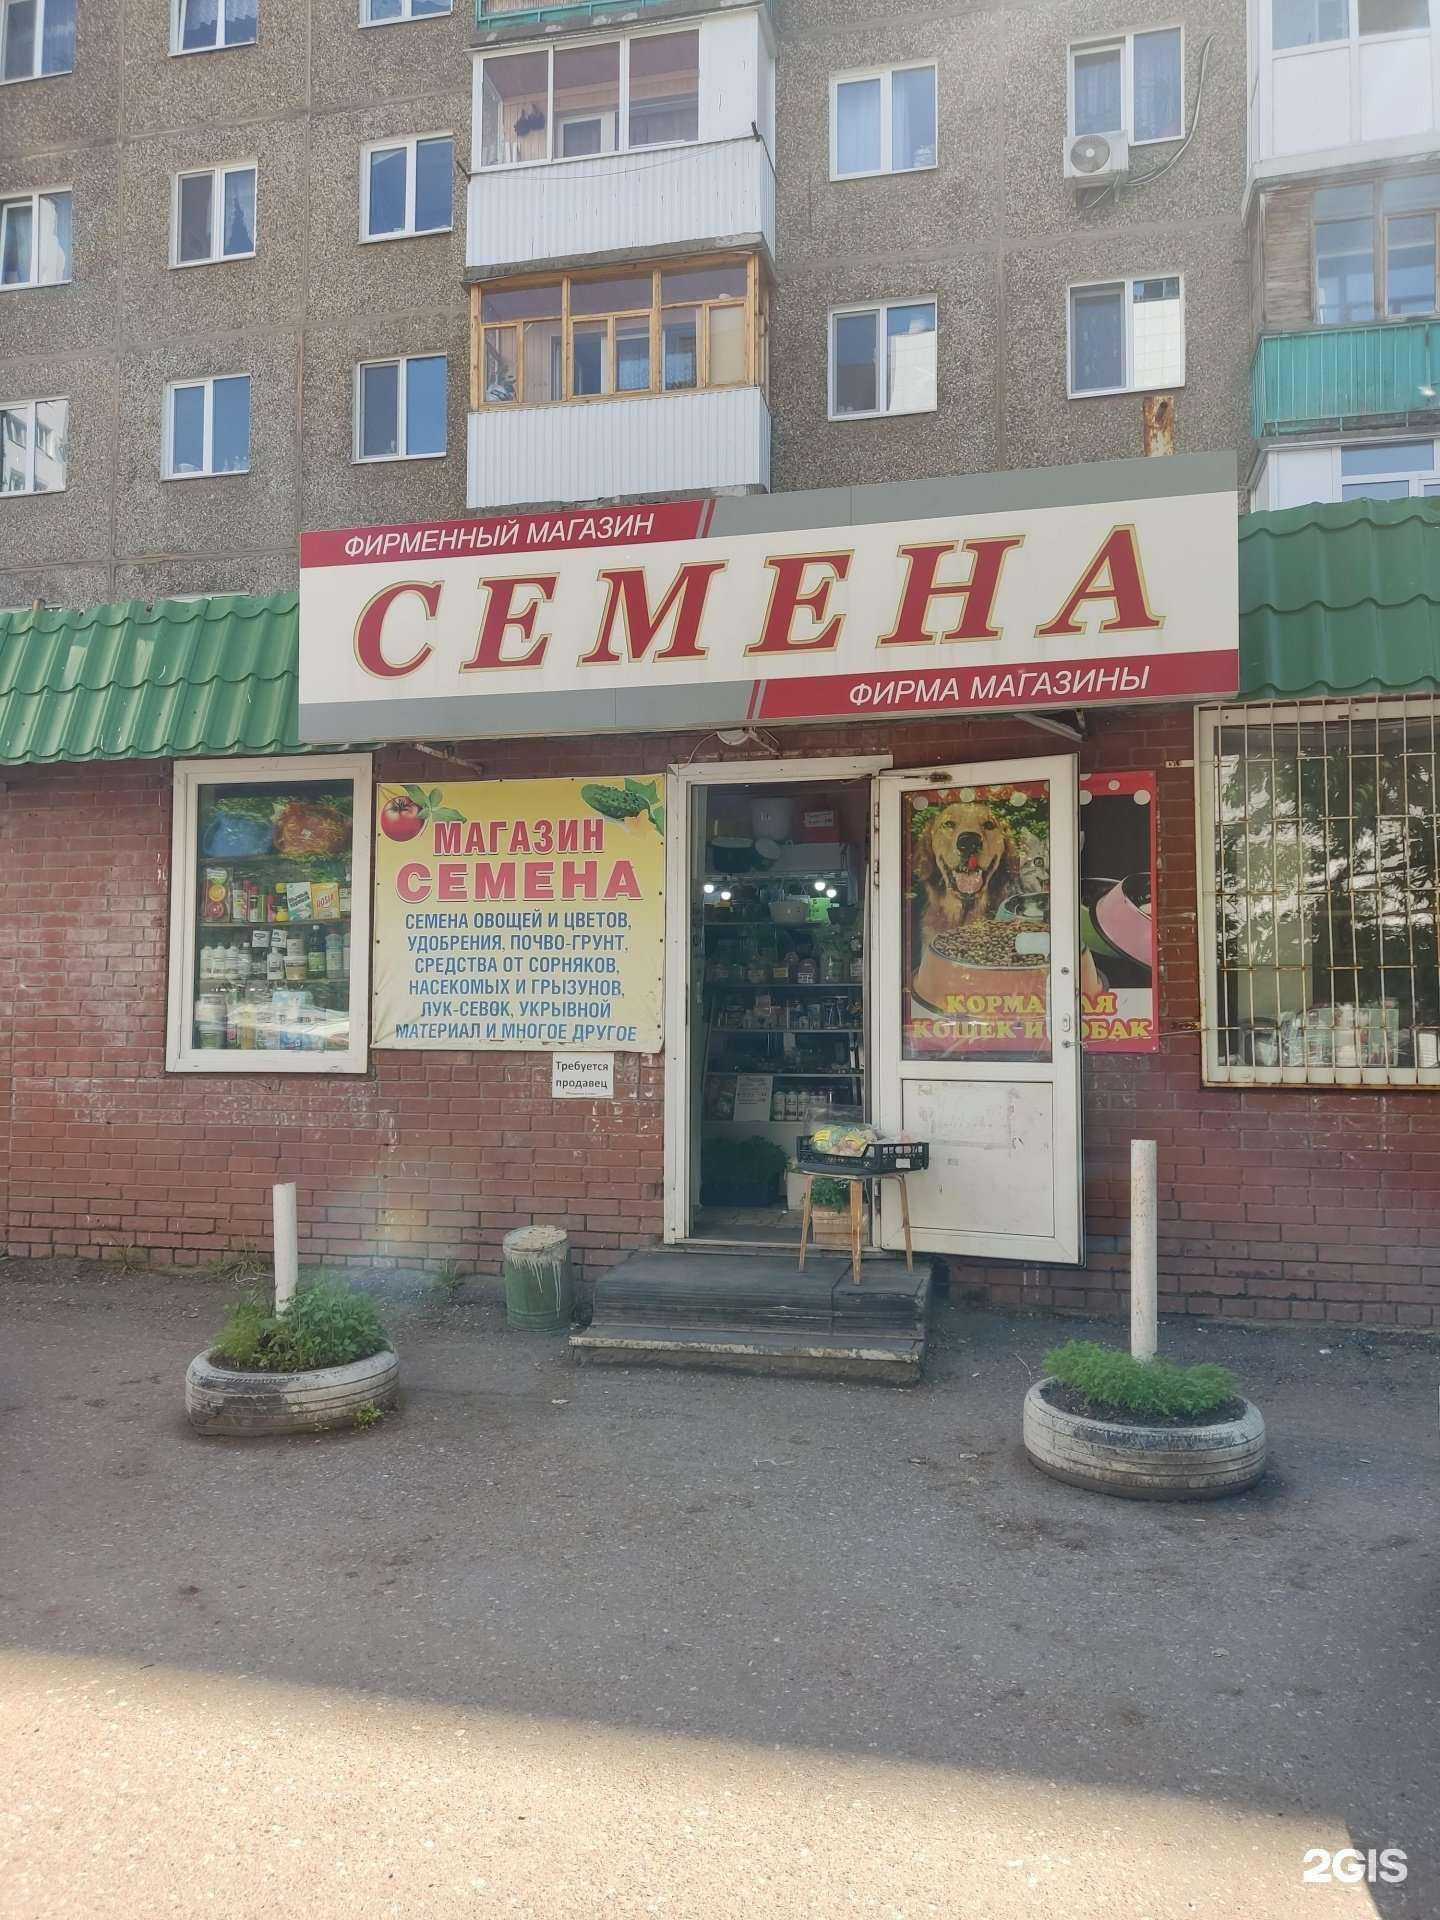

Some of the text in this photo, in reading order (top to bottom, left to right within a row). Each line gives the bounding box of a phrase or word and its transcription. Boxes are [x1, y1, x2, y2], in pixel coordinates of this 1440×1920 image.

[344, 512, 655, 558] ФИРМЕННЫЙ МАГАЗИН
[352, 523, 1167, 680] СЕМЕНА
[849, 665, 1150, 706] ФИРМА МАГАЗИНЫ
[433, 818, 605, 856] МАГАЗИН
[396, 859, 644, 903] СЕМЕНА
[405, 908, 632, 931] СЕМЕНА ОВОЩЕЙ И ЦВЕТОВ,
[407, 935, 506, 953] УДОБРЕНИЯ,
[415, 957, 620, 975] СРЕДСТВА ОТ СОРНЯКОВ,
[409, 979, 625, 998] НАСЕКОМЫХ И ГРЫЗУНОВ,
[420, 999, 611, 1019] ЛУК-СЕВОК, УКРЫВНОЙ
[944, 994, 1046, 1014] КОРМА
[395, 1022, 638, 1042] МАТЕРИАЛ И МНОГОЕ ДРУГОЕ
[911, 1019, 1017, 1040] КОШЕК
[1025, 1020, 1044, 1040] И
[556, 1060, 609, 1072] Требуется
[555, 1079, 608, 1089] продавец
